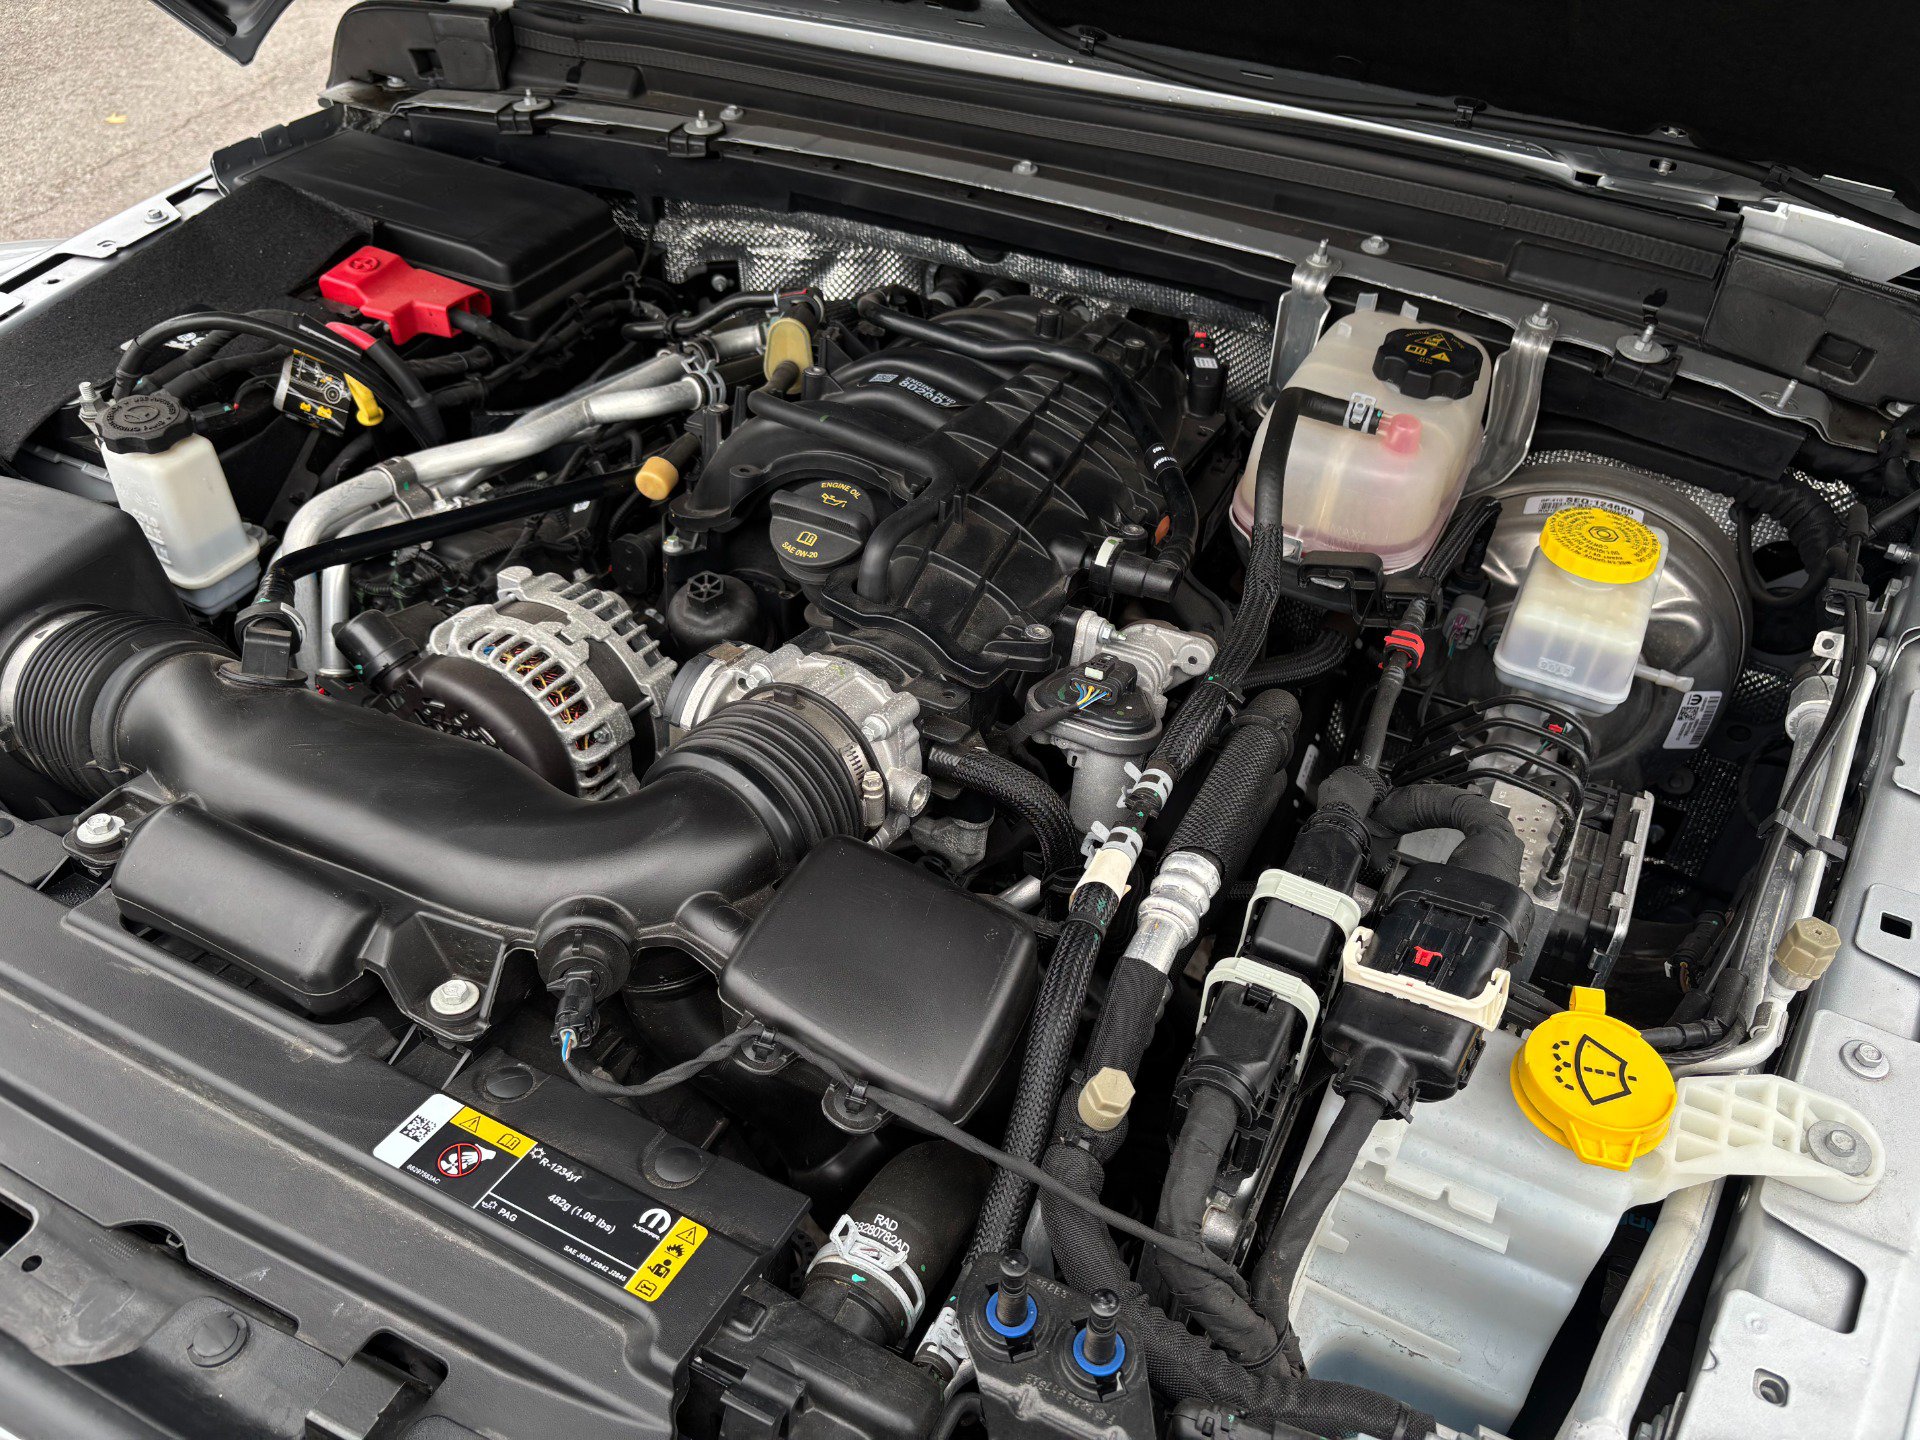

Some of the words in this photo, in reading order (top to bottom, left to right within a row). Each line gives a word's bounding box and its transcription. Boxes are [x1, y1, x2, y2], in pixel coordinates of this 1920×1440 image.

[821, 482, 851, 492] ENGINE
[850, 488, 862, 500] OIL
[781, 542, 796, 553] SAE
[795, 549, 818, 558] 0W-20
[538, 1157, 582, 1183] R-1234yf
[497, 1207, 518, 1222] PAG
[547, 1194, 572, 1212] 482g
[571, 1206, 597, 1223] (1.06
[595, 1218, 616, 1235] lbs)
[873, 1213, 899, 1232] RAD
[563, 1245, 578, 1255] SAE
